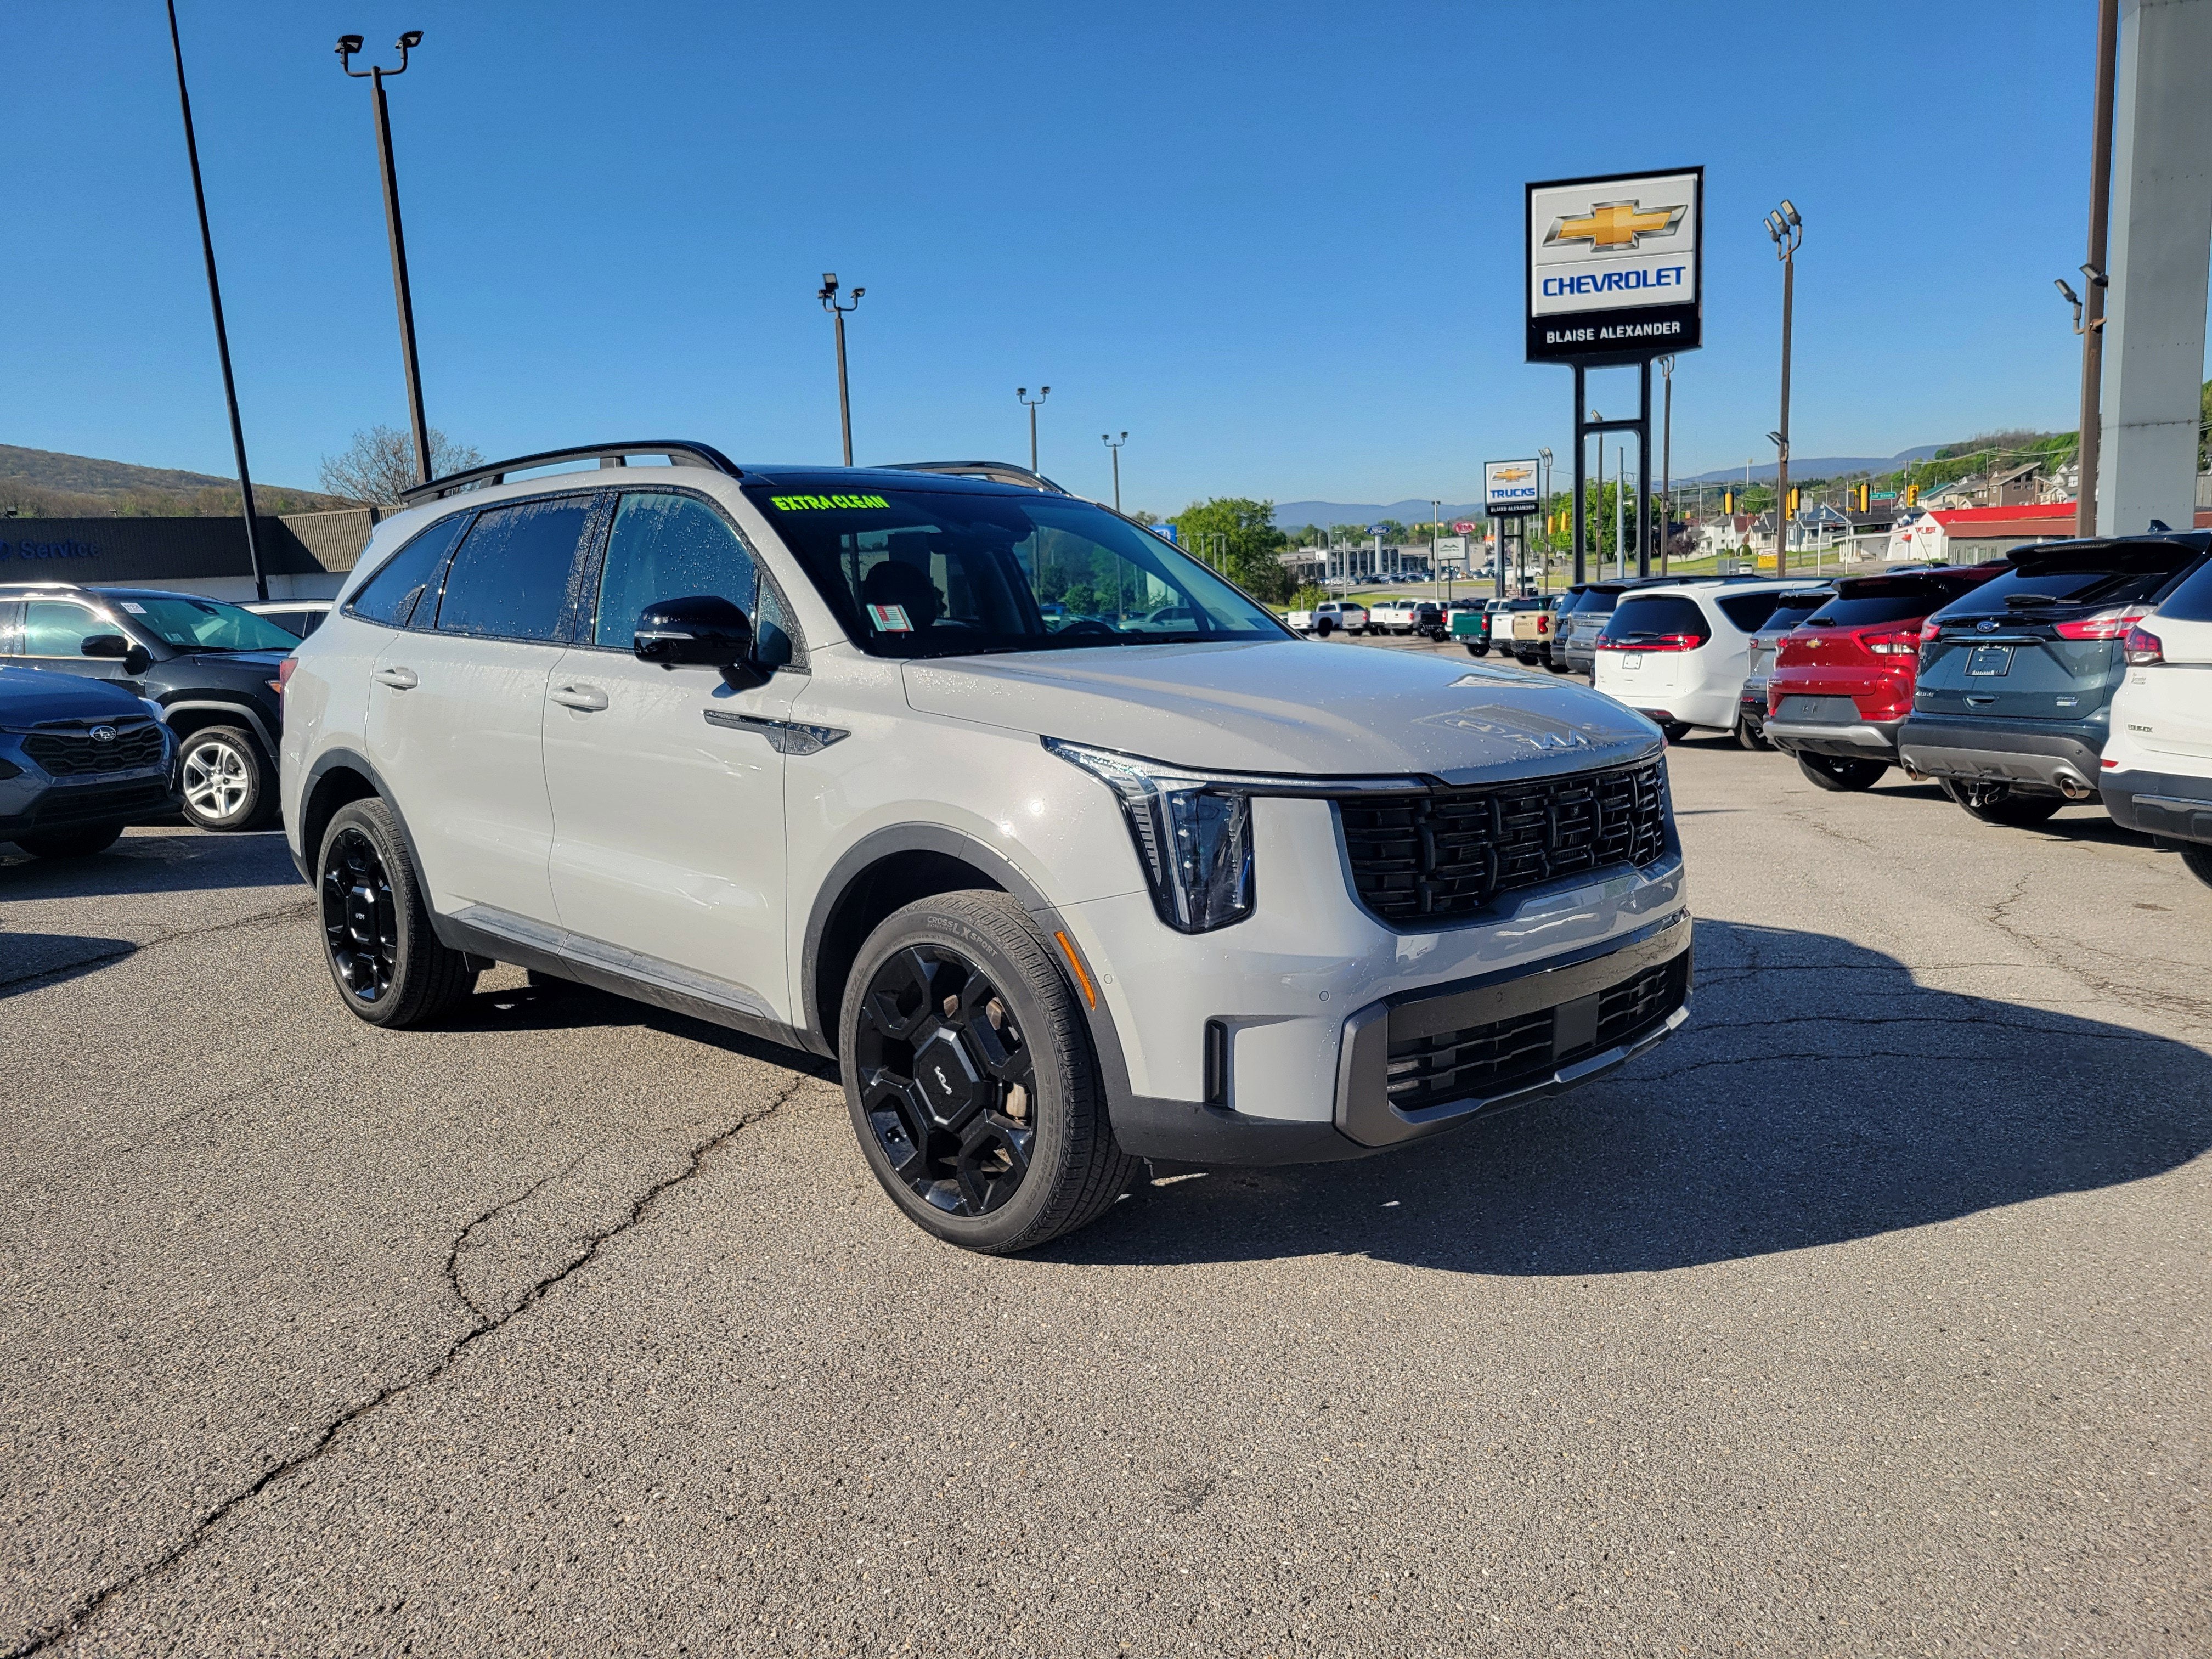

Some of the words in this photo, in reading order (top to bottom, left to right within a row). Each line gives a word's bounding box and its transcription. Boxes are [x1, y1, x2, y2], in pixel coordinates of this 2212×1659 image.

[1542, 266, 1686, 297] CHEVROLET
[1547, 328, 1595, 344] BLAISE
[1600, 321, 1681, 339] ALEXANDER
[771, 495, 836, 511] EXTRA
[832, 495, 890, 509] CLEAN
[1490, 488, 1536, 499] TRUCKS
[19, 539, 100, 559] Service
[927, 916, 953, 928] CROSS
[970, 933, 998, 957] SPORT
